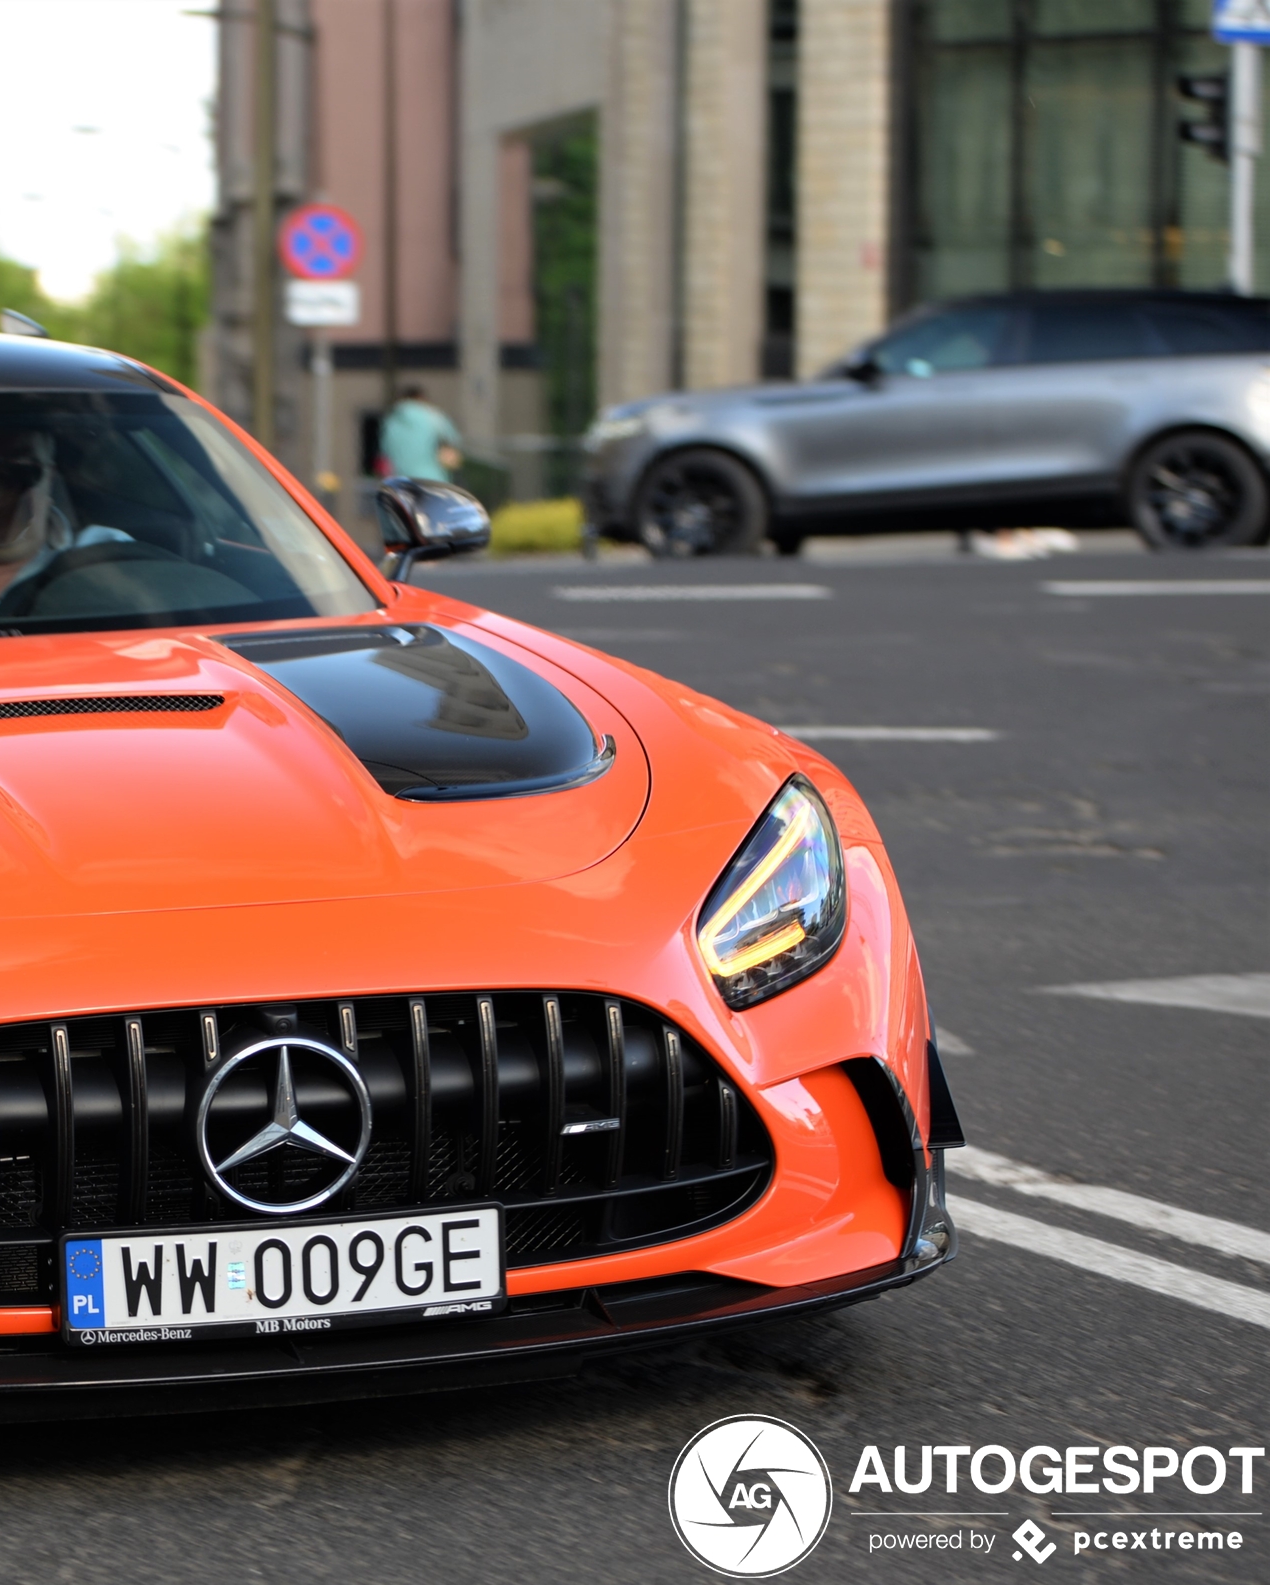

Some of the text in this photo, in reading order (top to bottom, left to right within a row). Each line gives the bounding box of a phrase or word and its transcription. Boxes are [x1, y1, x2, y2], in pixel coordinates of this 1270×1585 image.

[120, 1218, 482, 1318] WW 009GE
[73, 1295, 100, 1314] PL
[439, 1301, 492, 1314] AMG
[255, 1318, 332, 1334] MB Motors
[97, 1328, 192, 1343] Mercedes-Benz
